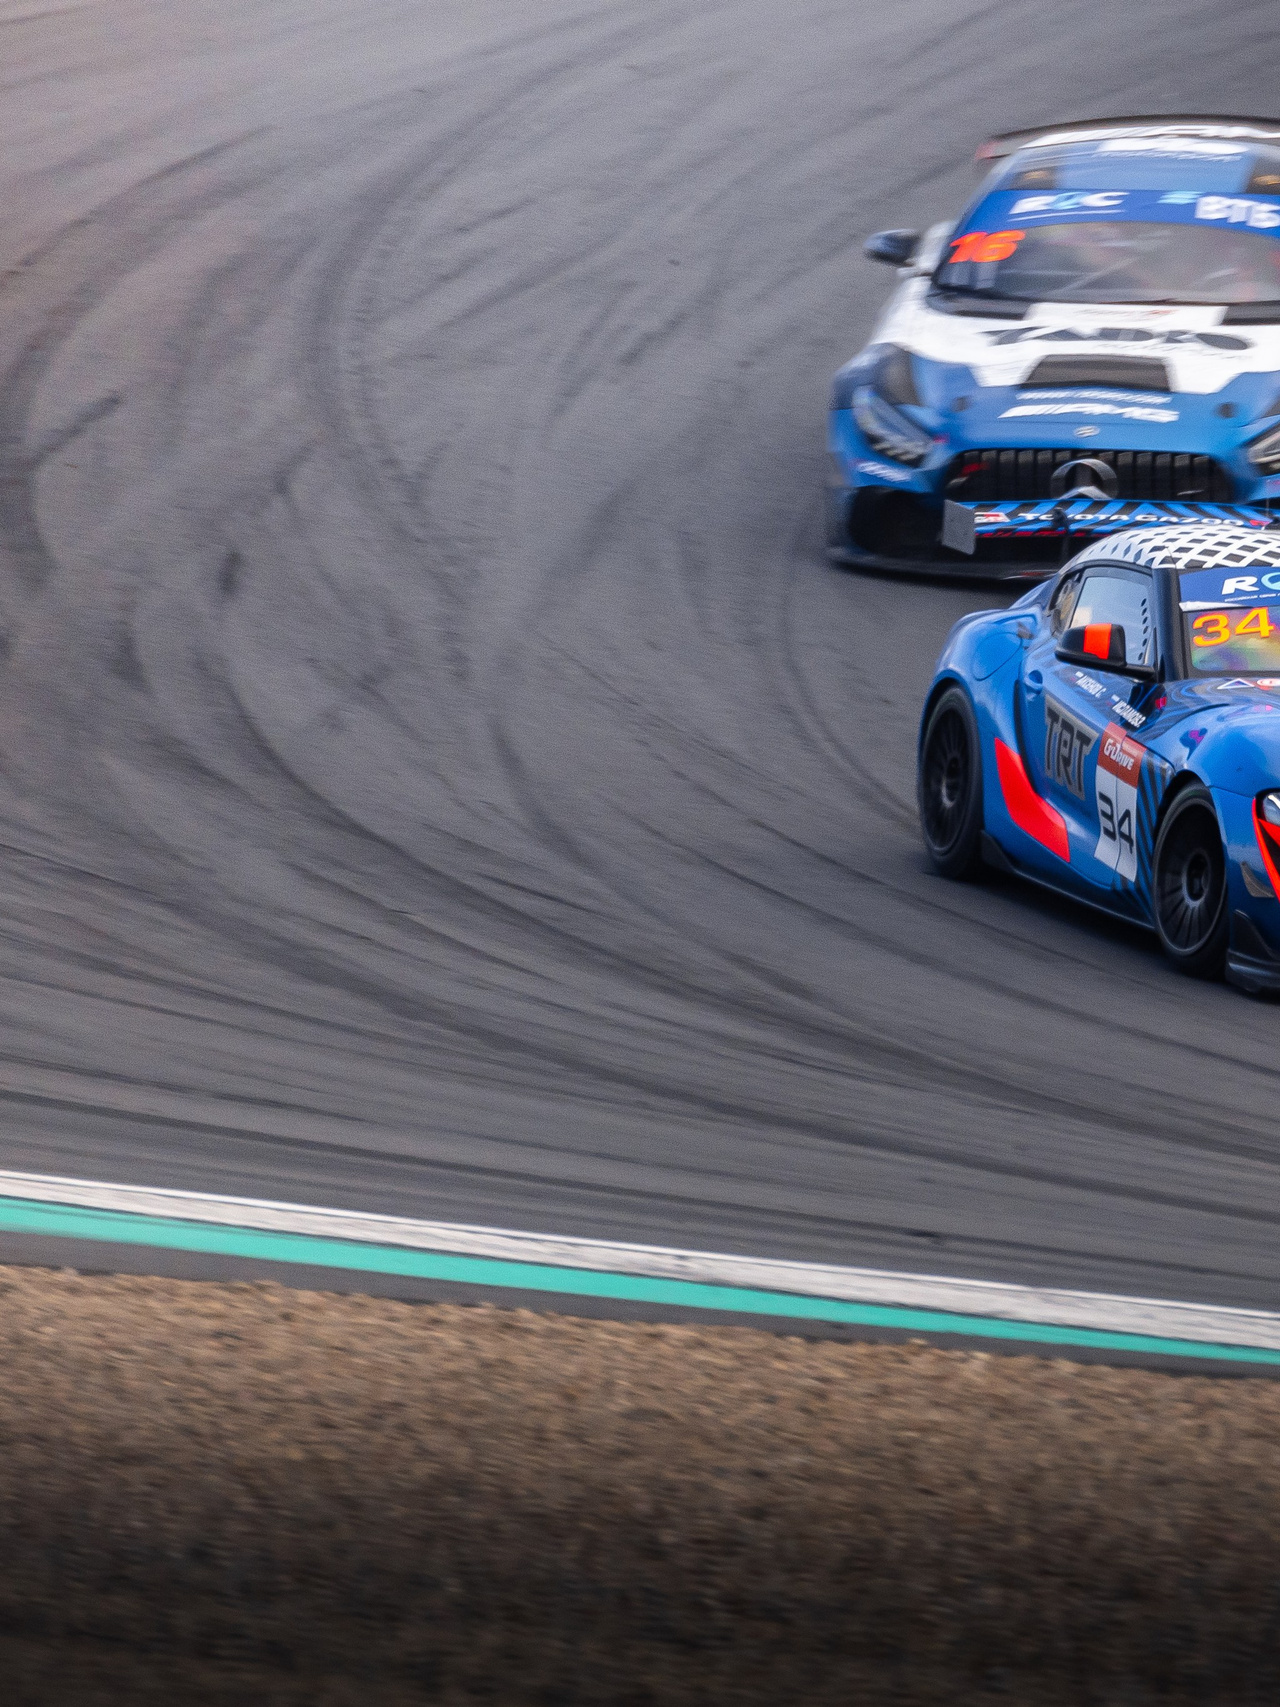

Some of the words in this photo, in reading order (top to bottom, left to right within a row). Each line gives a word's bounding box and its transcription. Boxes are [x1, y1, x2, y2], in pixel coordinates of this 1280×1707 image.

[948, 229, 1026, 263] 16
[1192, 606, 1276, 647] 34
[1045, 698, 1098, 799] TRT
[1098, 791, 1134, 855] 34
